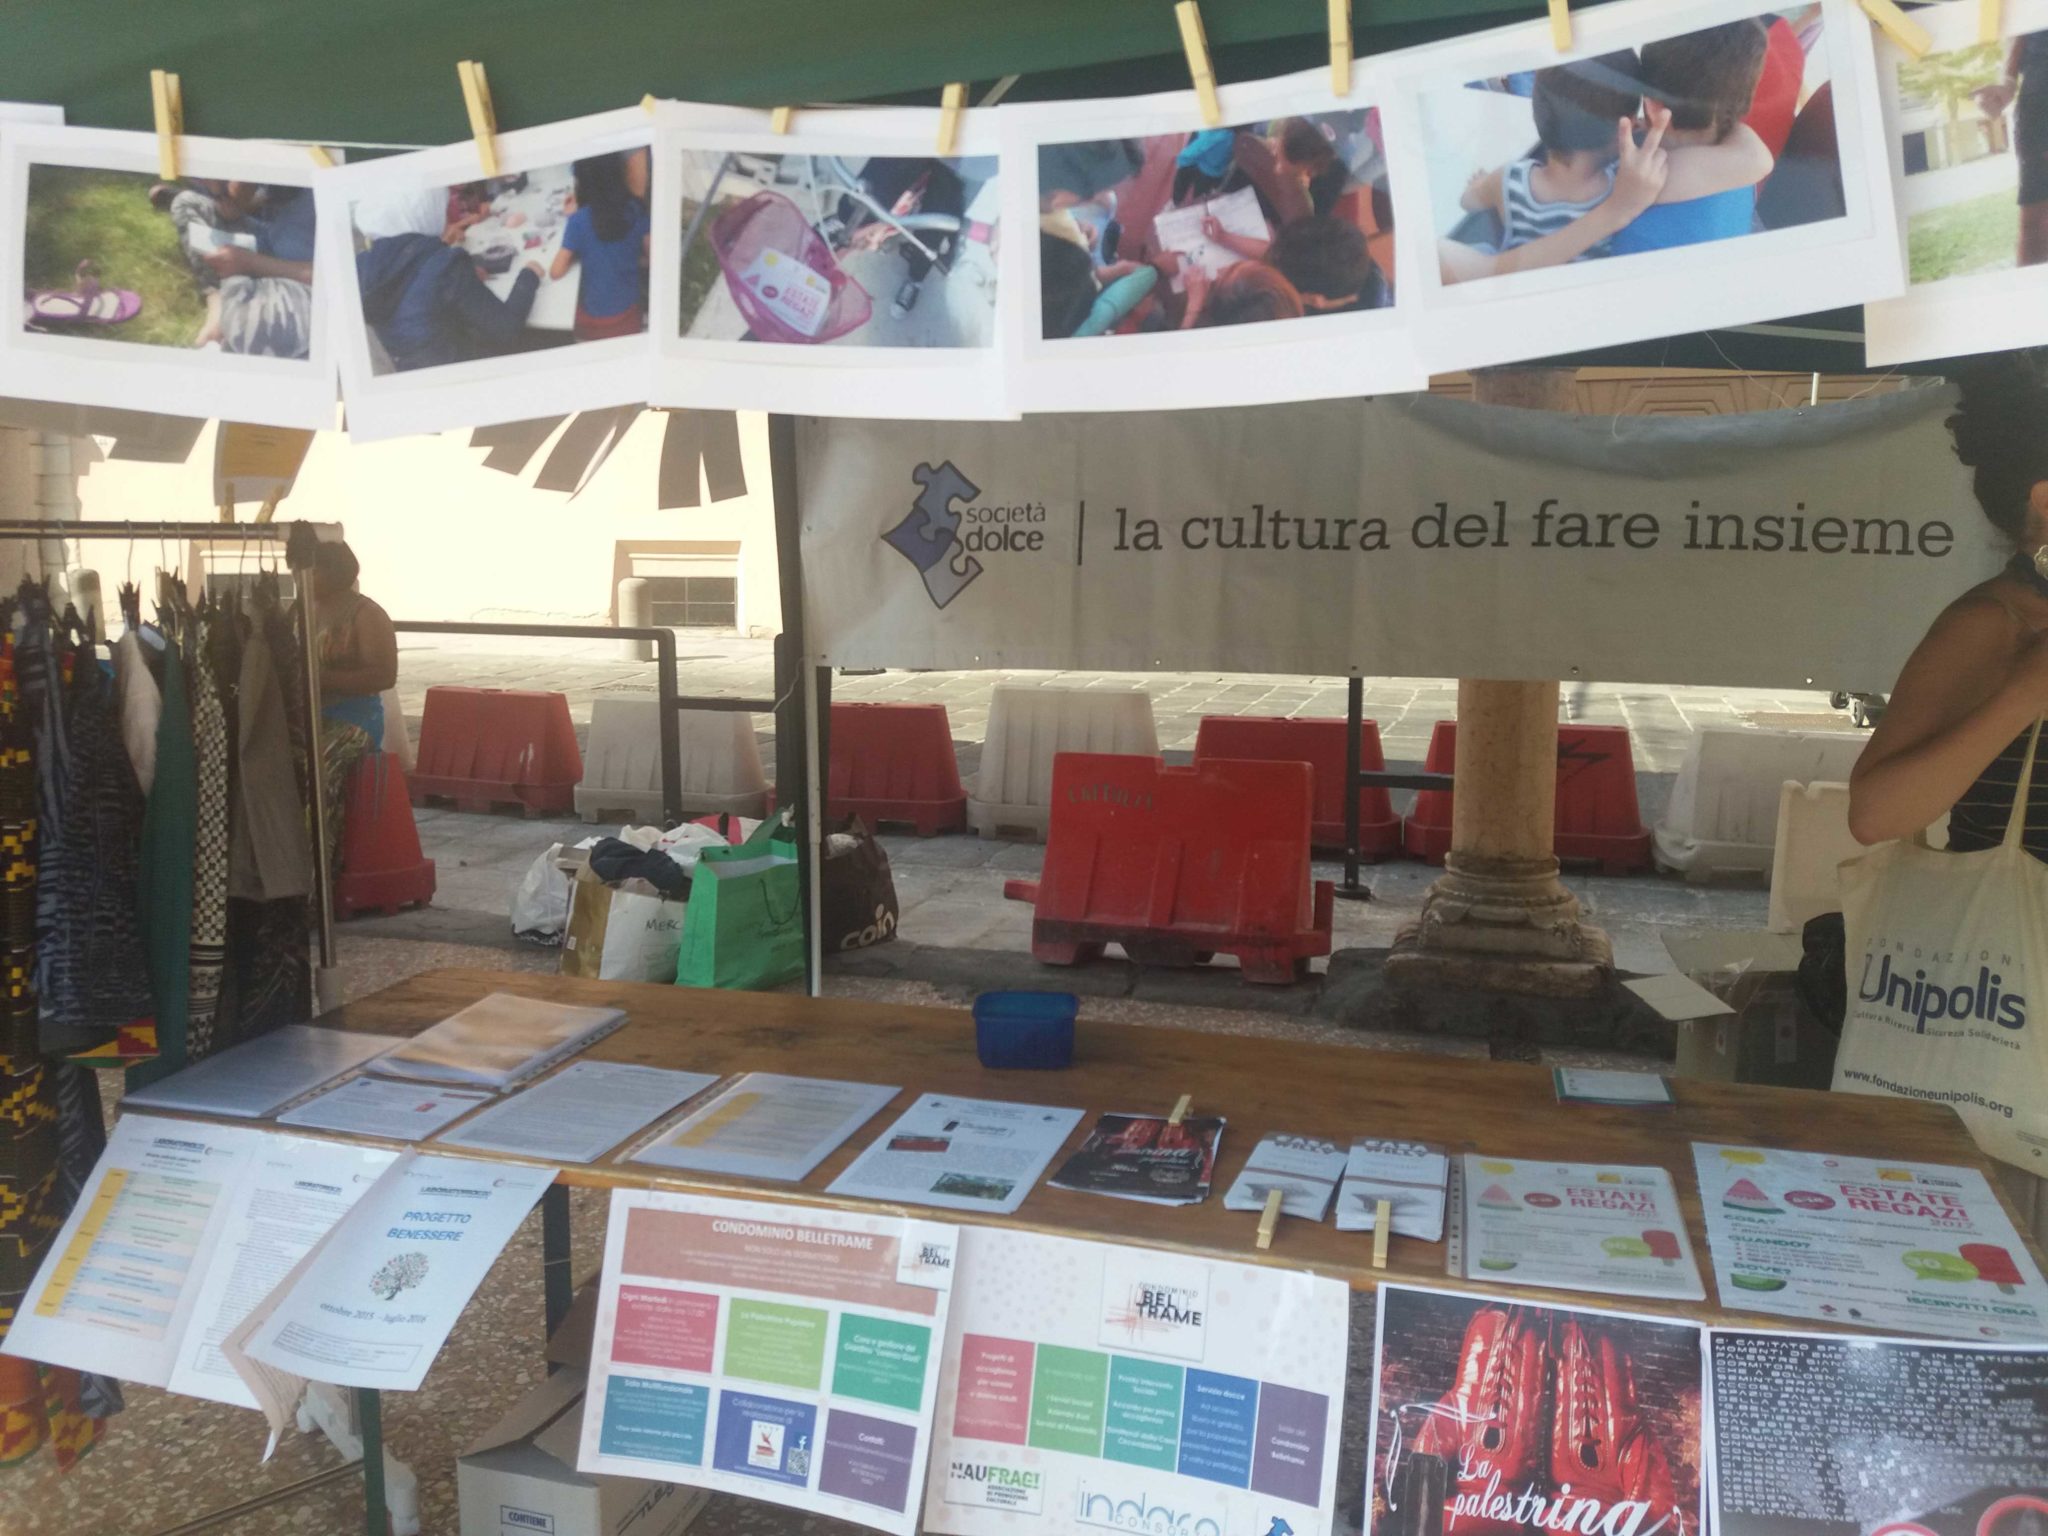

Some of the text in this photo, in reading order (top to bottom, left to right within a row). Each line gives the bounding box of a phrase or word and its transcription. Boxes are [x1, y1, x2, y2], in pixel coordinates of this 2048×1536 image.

[965, 501, 1047, 524] società
[964, 524, 1045, 553] dolce
[1113, 499, 1955, 558] la cultura del fare insieme
[840, 904, 896, 950] coin
[1866, 938, 2026, 971] FONDAZION
[1858, 952, 2027, 1035] Unipolis
[1843, 1069, 2014, 1119] www.fondazioneunipolis.org
[1839, 1183, 1965, 1208] ESTATE
[402, 1211, 472, 1224] PROGETTO
[386, 1227, 464, 1242] BENESSERE
[712, 1219, 873, 1251] CONDOMINIO BELLETRAME
[1143, 1290, 1177, 1308] BEL
[1135, 1302, 1203, 1327] TRAME
[1715, 1345, 1783, 1356] MOMENTI
[1736, 1338, 1809, 1351] CAPITATO
[1716, 1352, 1798, 1365] PALESTRE
[1456, 1442, 1493, 1482] La
[951, 1462, 1041, 1490] NAUFRAGI
[1450, 1469, 1660, 1536] palestrina
[507, 1511, 548, 1529] CONTIENE
